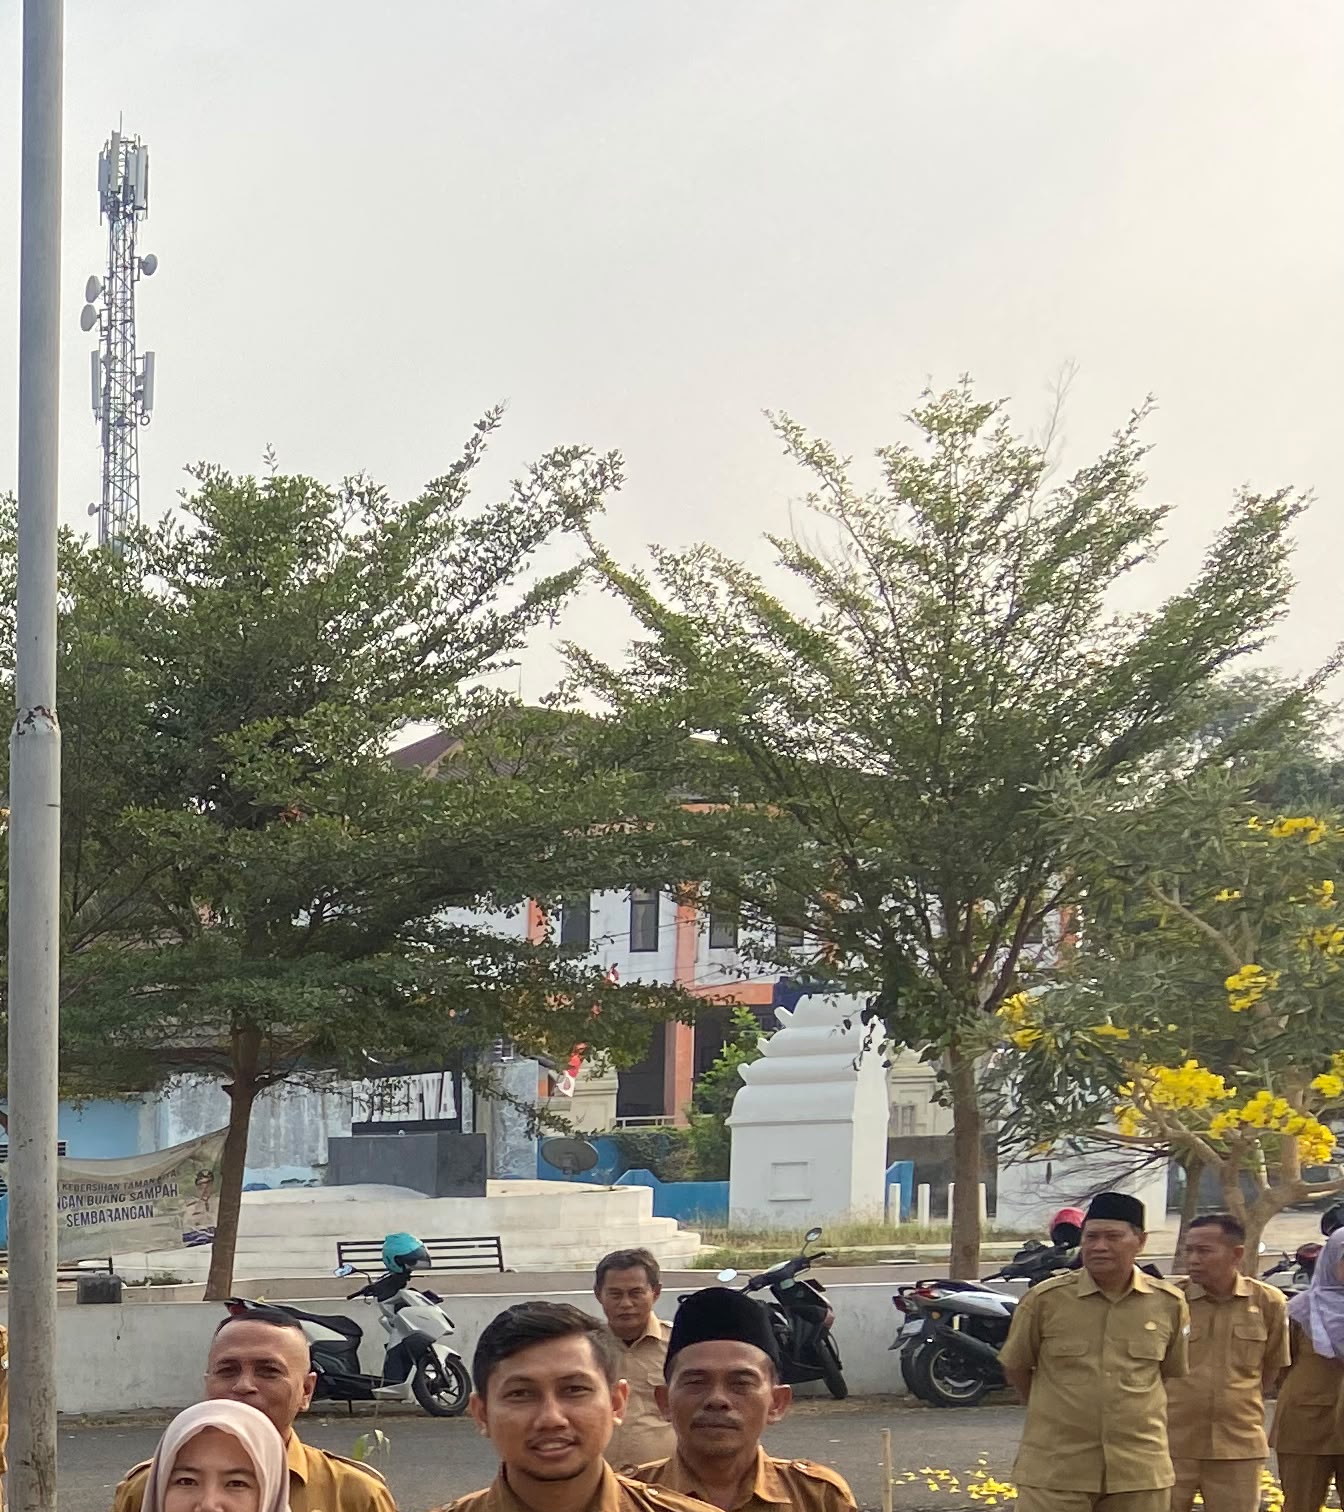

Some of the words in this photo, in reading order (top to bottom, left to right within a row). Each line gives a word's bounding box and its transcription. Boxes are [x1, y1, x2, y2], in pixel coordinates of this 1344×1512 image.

[57, 1194, 83, 1210] NGAN
[87, 1193, 126, 1206] BUANG
[130, 1183, 178, 1202] SAMPAH
[66, 1204, 154, 1228] SEMBARANGAN
